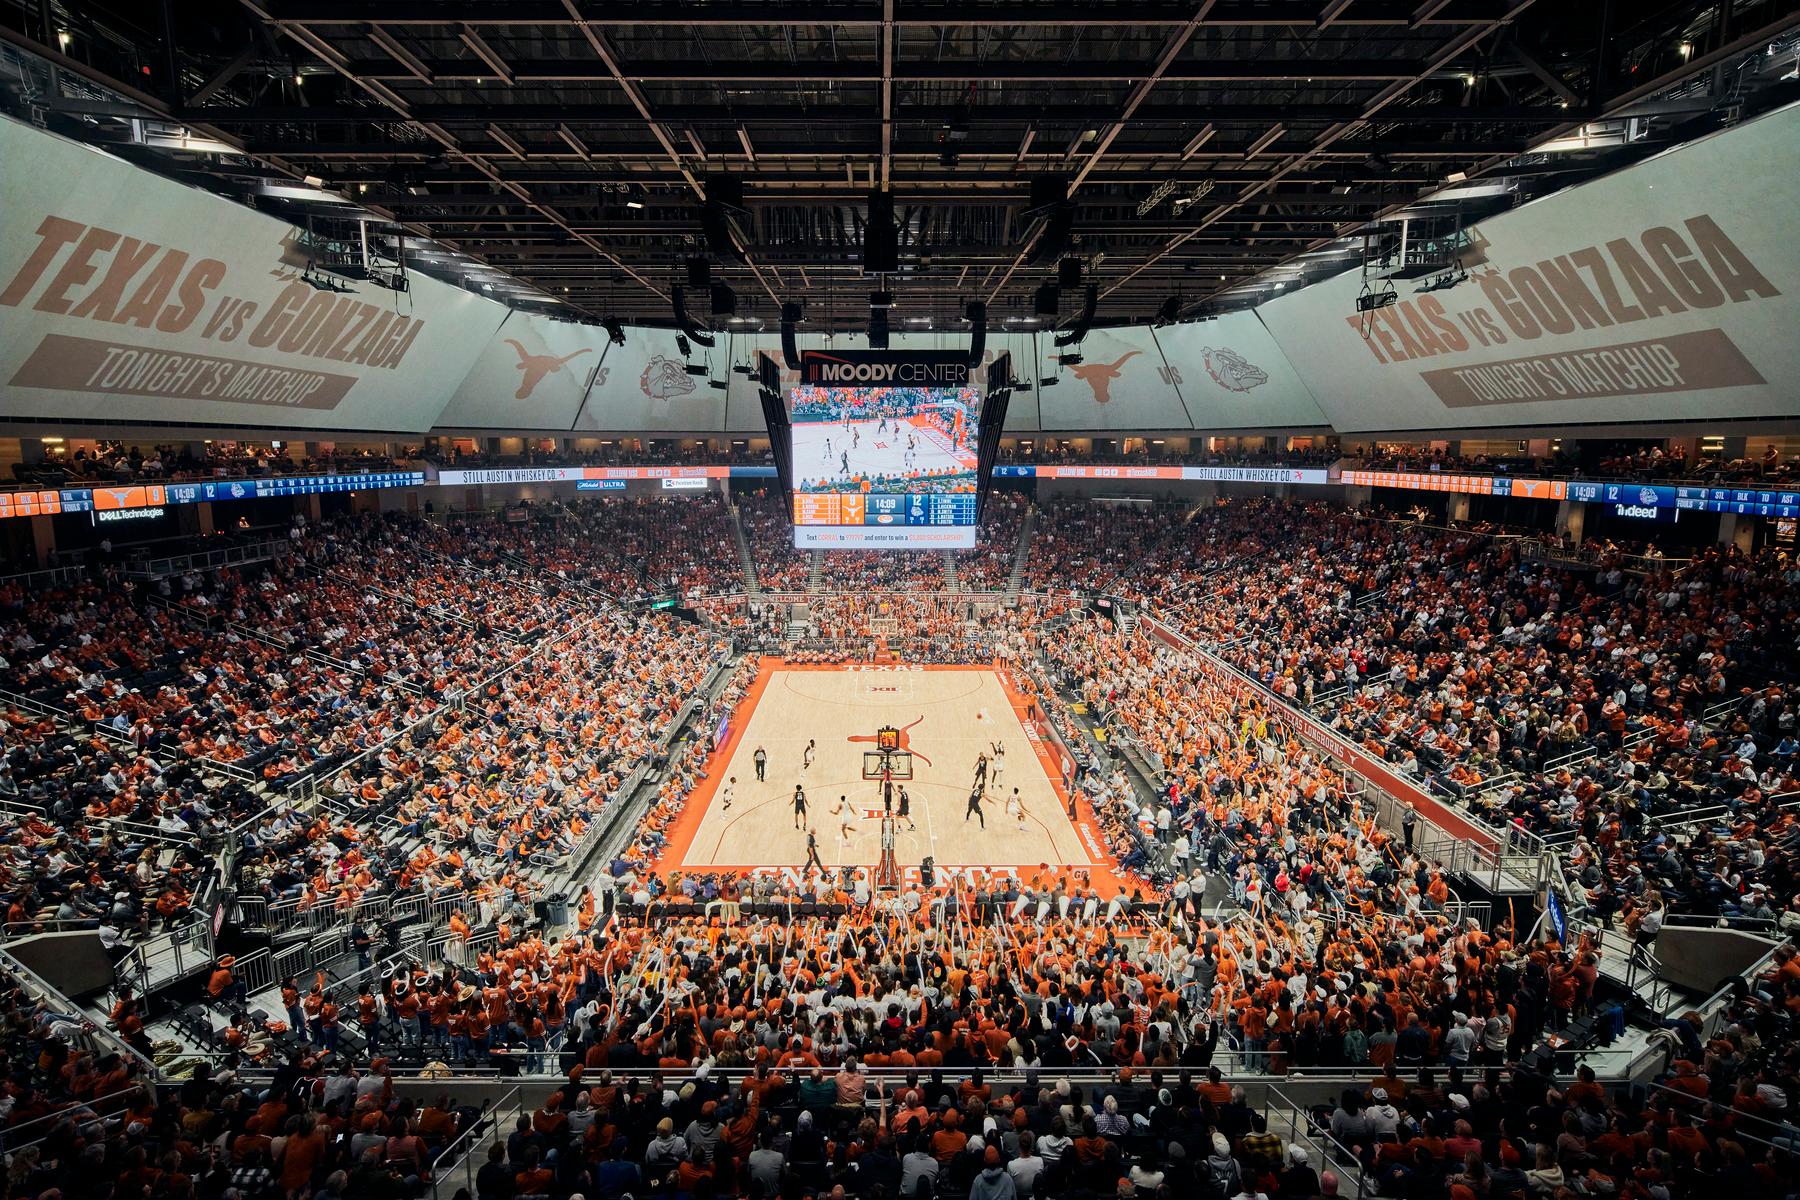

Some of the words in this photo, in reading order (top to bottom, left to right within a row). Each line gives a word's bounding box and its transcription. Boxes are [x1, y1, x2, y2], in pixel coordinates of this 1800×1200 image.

[1479, 214, 1782, 341] GONZAGA
[0, 215, 226, 333] TEXAS
[201, 296, 258, 343] VS
[248, 282, 425, 370] GONZAGA
[1345, 294, 1470, 364] TEXAS
[1457, 308, 1507, 347] VS
[86, 347, 230, 397] TONIGHT'S
[222, 365, 325, 404] MATCHUP
[823, 363, 897, 382] MOODY
[899, 363, 967, 382] CENTER
[1453, 358, 1570, 403] TONIGHT'S
[1559, 343, 1687, 395] MATCHUP
[463, 471, 485, 483] STILL
[486, 469, 513, 483] AUSTIN
[514, 469, 546, 481] WHISKEY
[1199, 468, 1217, 479] STILL
[1219, 469, 1244, 480] AUSTIN
[1245, 470, 1279, 481] WHISKEY
[174, 487, 195, 500] 14:09
[205, 485, 215, 498] 12
[1575, 486, 1596, 498] 14:09
[1608, 486, 1618, 500] 12
[1700, 489, 1706, 499] 4
[1714, 491, 1724, 500] STL
[1737, 492, 1748, 501] BLK
[1762, 493, 1770, 502] TO
[1781, 494, 1794, 504] AST
[876, 498, 896, 509] 14:09
[913, 495, 922, 506] 12
[1677, 499, 1693, 509] FOULS
[1698, 501, 1704, 510] 2
[99, 509, 123, 521] DELL
[122, 508, 164, 519] Technologies
[1615, 503, 1658, 519] indeed
[1761, 505, 1768, 515] 3
[1782, 506, 1789, 516] 3
[842, 664, 924, 672] TEXAS
[1282, 709, 1303, 731] TEXAS
[1303, 721, 1345, 758] LONGHORNS
